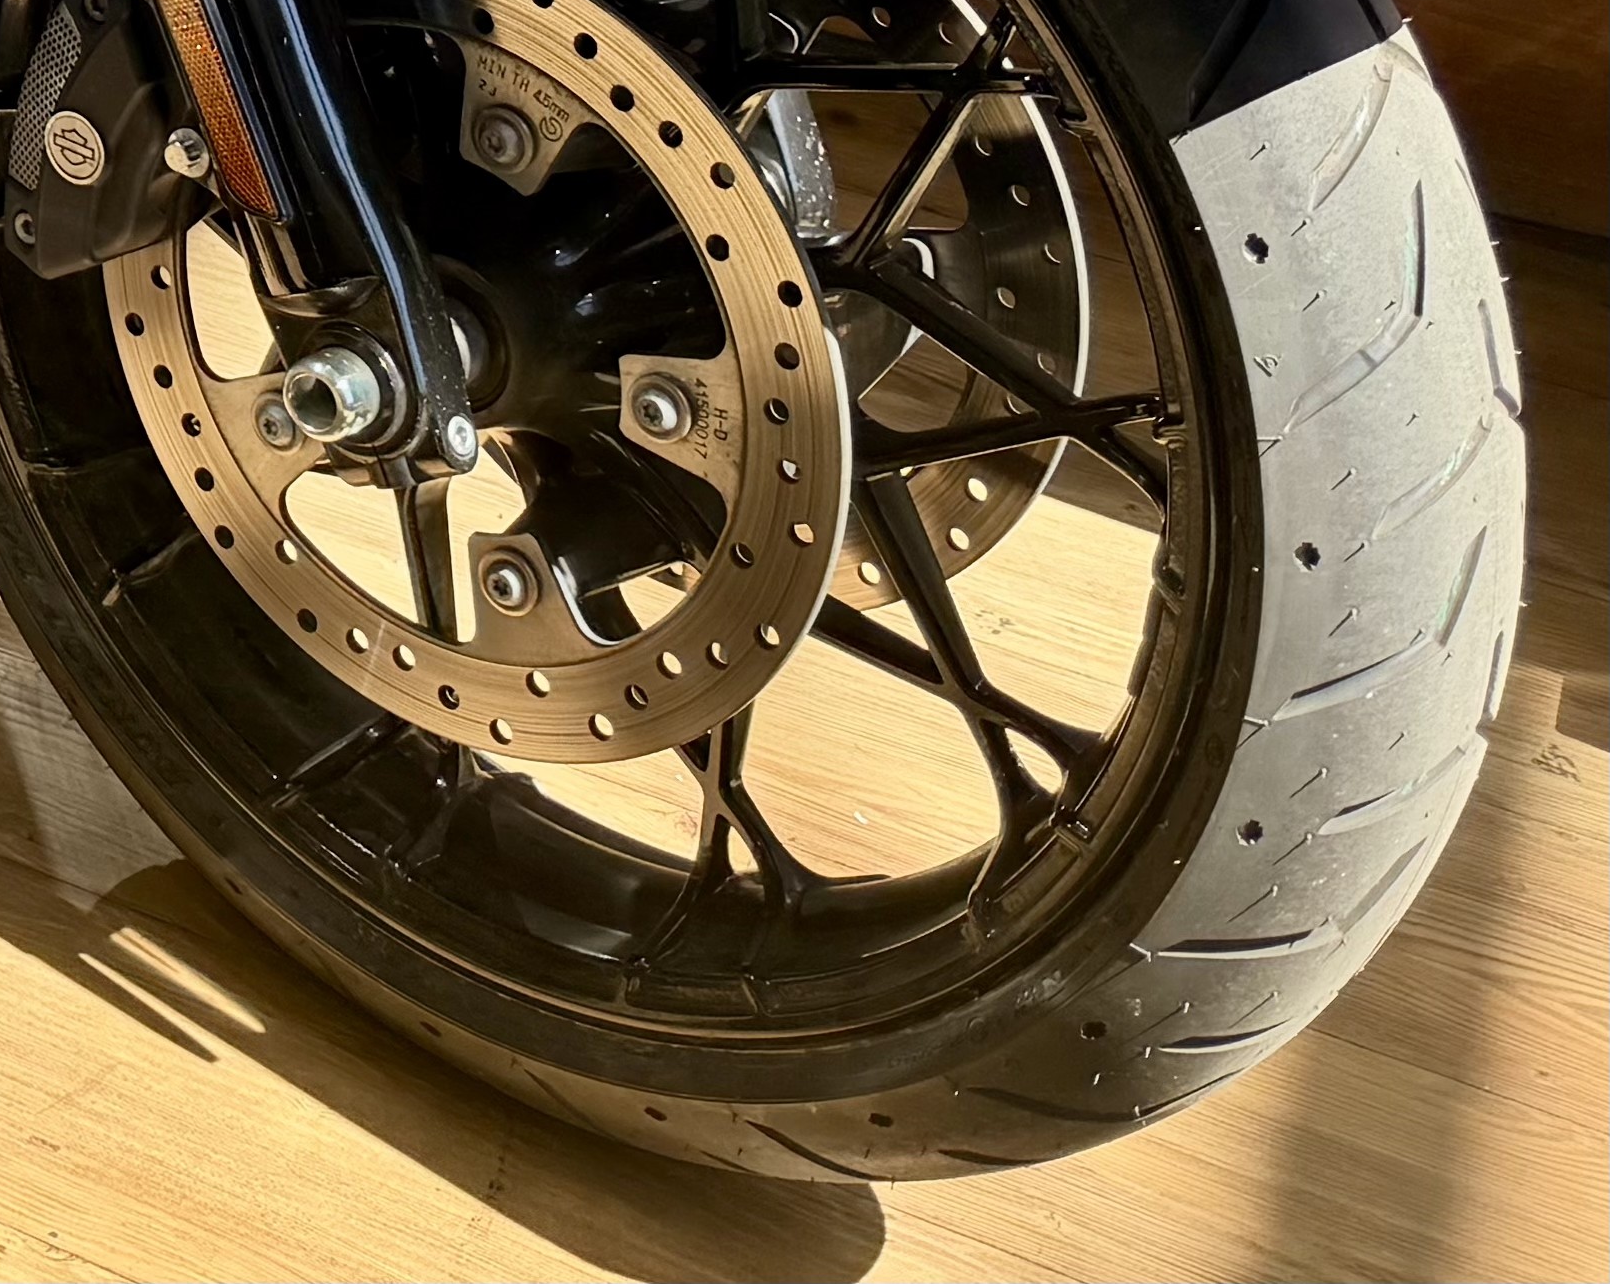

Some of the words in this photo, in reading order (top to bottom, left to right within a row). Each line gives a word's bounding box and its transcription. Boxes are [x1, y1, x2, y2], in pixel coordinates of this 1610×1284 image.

[477, 54, 507, 79] MIN
[693, 377, 710, 460] 41500017
[713, 407, 729, 442] H-D
